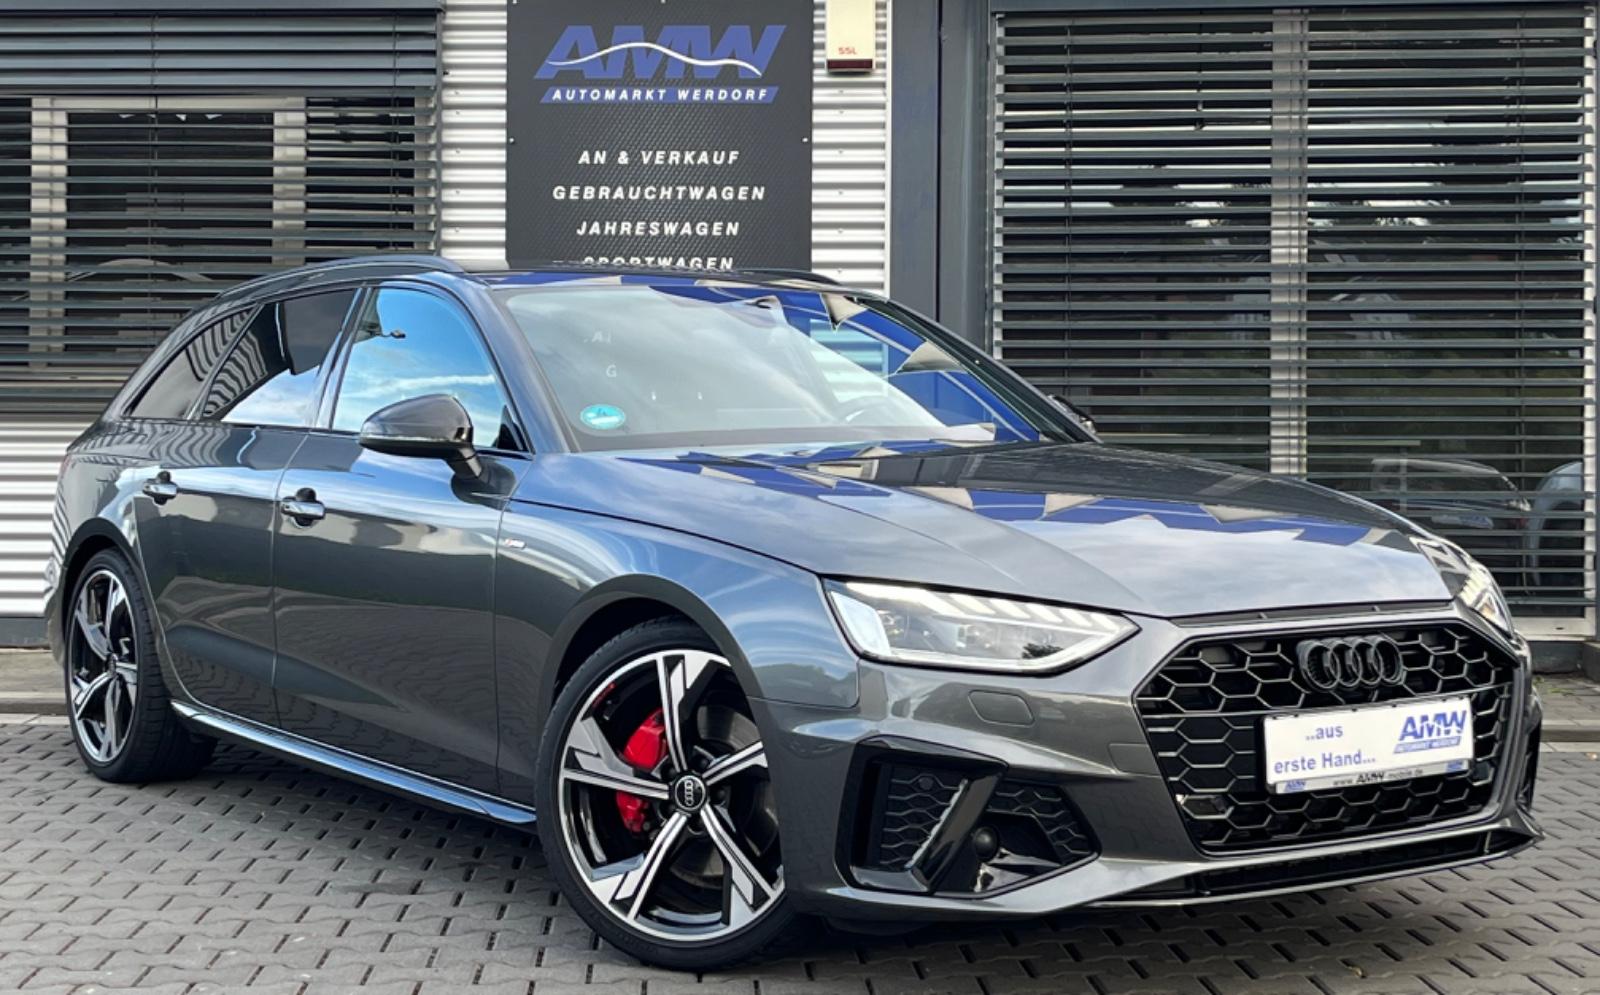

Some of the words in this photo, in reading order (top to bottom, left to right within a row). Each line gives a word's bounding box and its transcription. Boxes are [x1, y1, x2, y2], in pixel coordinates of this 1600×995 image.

[534, 25, 786, 79] AMW
[552, 89, 666, 101] AUTOMARKT
[677, 89, 768, 101] WERDORF
[578, 151, 606, 164] AN
[618, 151, 629, 164] &
[642, 151, 740, 164] VERKAUF
[553, 186, 765, 200] GEBRAUCHTWAGEN
[577, 222, 740, 236] JAHRESWAGEN
[1399, 710, 1467, 741] AMW
[1274, 755, 1316, 774] erste
